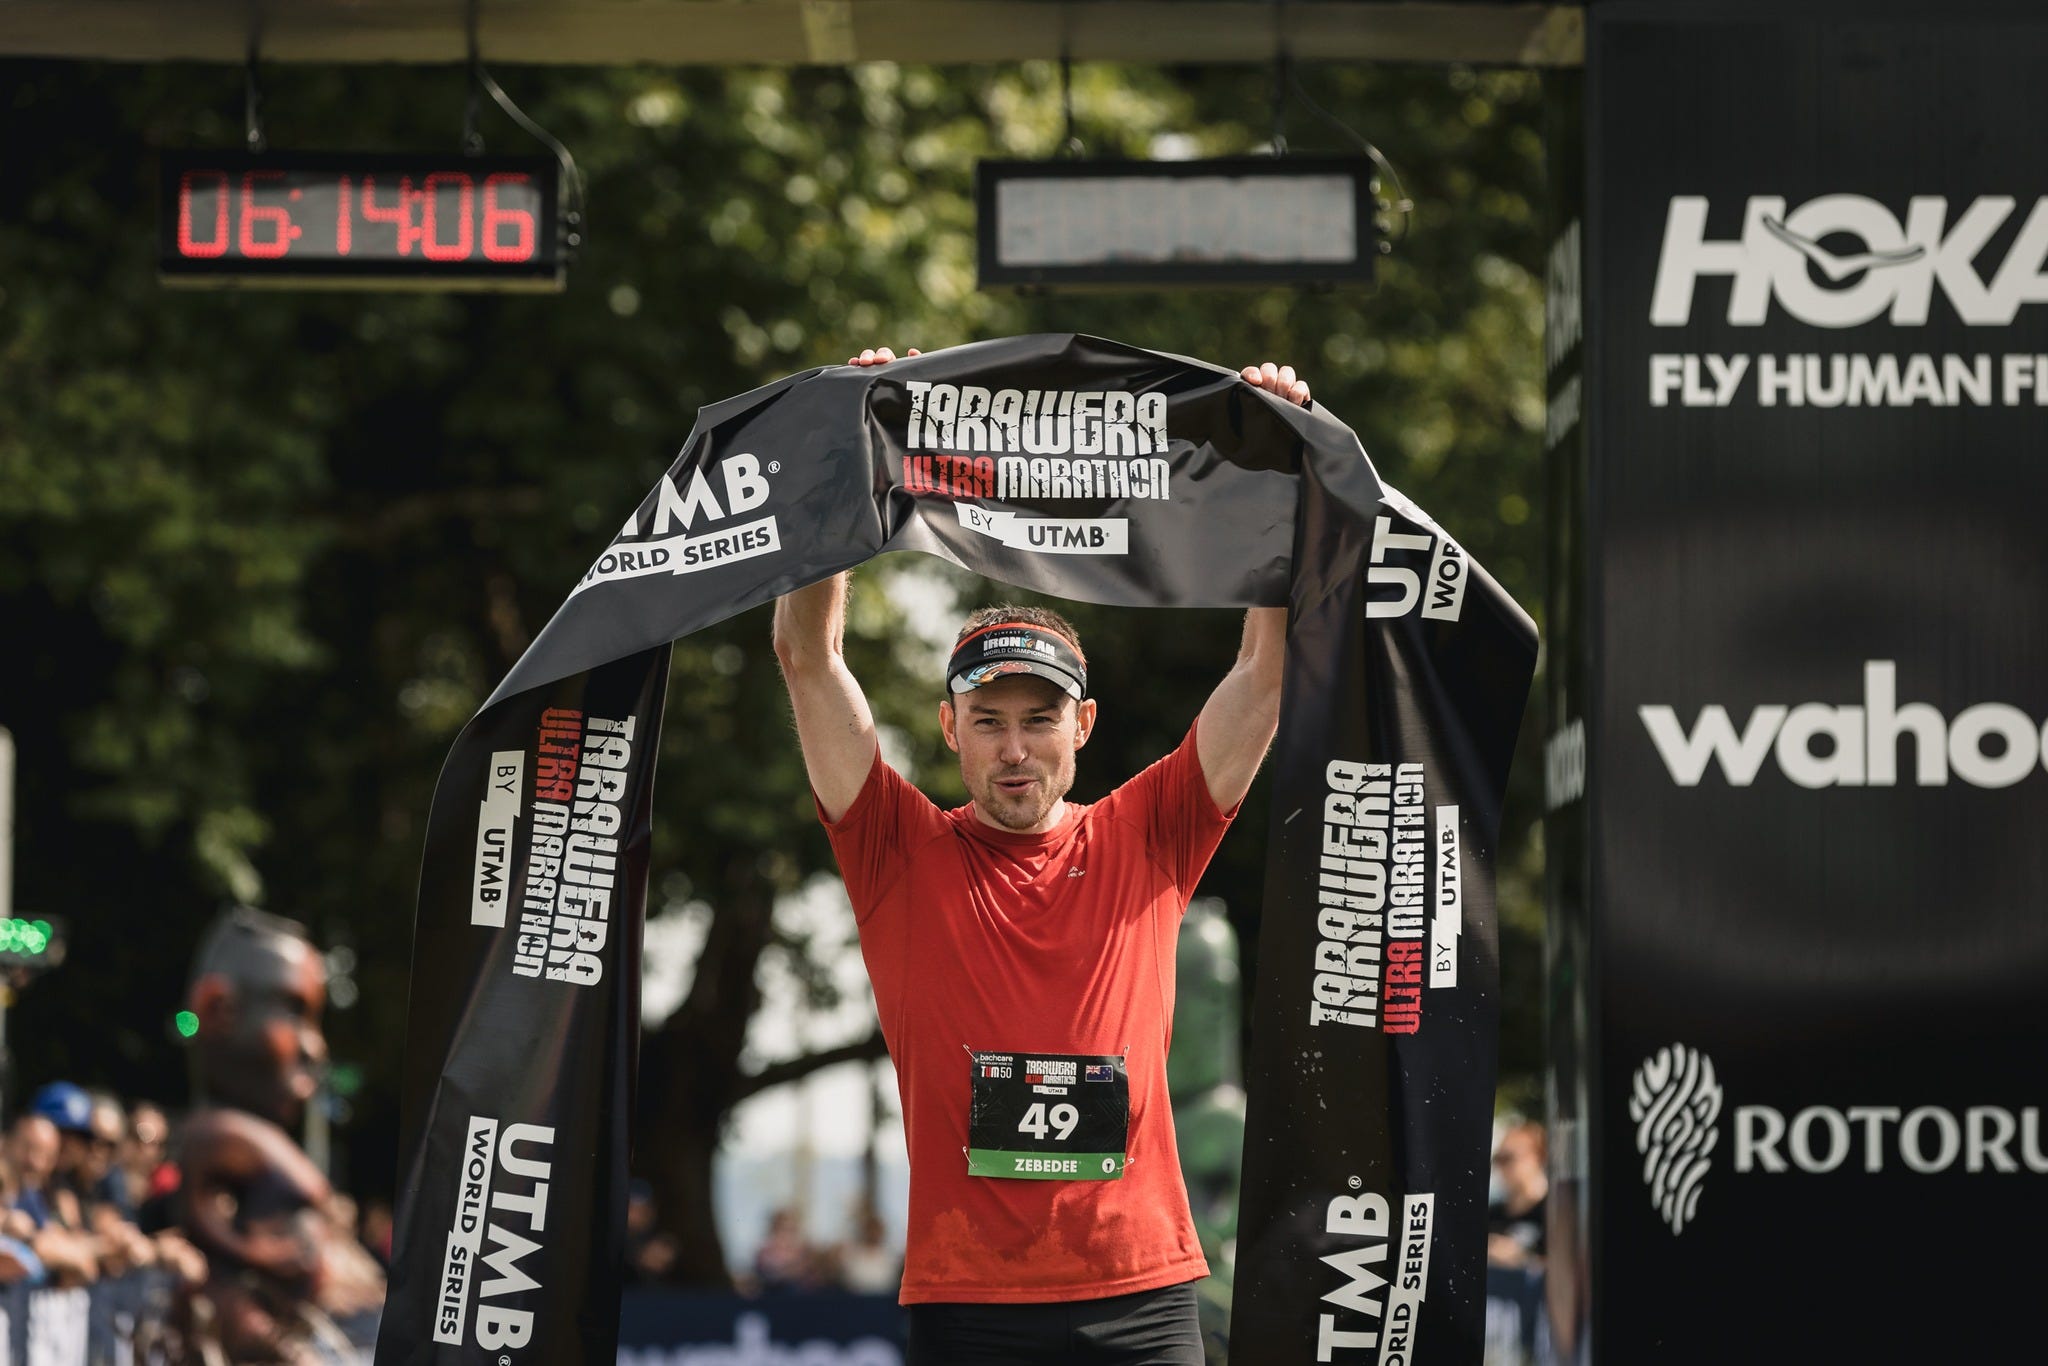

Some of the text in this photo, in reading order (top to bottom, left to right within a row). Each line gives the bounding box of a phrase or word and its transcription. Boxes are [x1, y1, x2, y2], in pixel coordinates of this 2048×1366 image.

[178, 171, 535, 261] 06:14:06
[1649, 353, 1750, 407] FLY
[1757, 353, 1992, 408] HUMAN
[906, 380, 1169, 456] TARAWERA
[903, 455, 1170, 501] ULTRA MARATHON
[969, 509, 993, 531] BY
[683, 526, 771, 565] SERIES
[983, 649, 1006, 657] WORLD
[1637, 660, 2048, 789] waho
[495, 765, 517, 795] BY
[512, 706, 583, 978] ULTRA MARATHON
[545, 716, 636, 986] TARAWERA
[1310, 759, 1392, 1028] TARAWERA
[1383, 763, 1425, 1035] ULTRA MARATHON
[1436, 942, 1451, 973] BY
[980, 1054, 1014, 1063] bachcare
[1025, 1060, 1077, 1076] TARAWERA
[1018, 1103, 1079, 1140] 49
[1014, 1158, 1078, 1173] ZEBEDEE
[440, 1128, 491, 1336] WORLD SERIES
[1402, 1202, 1428, 1290] SERIES
